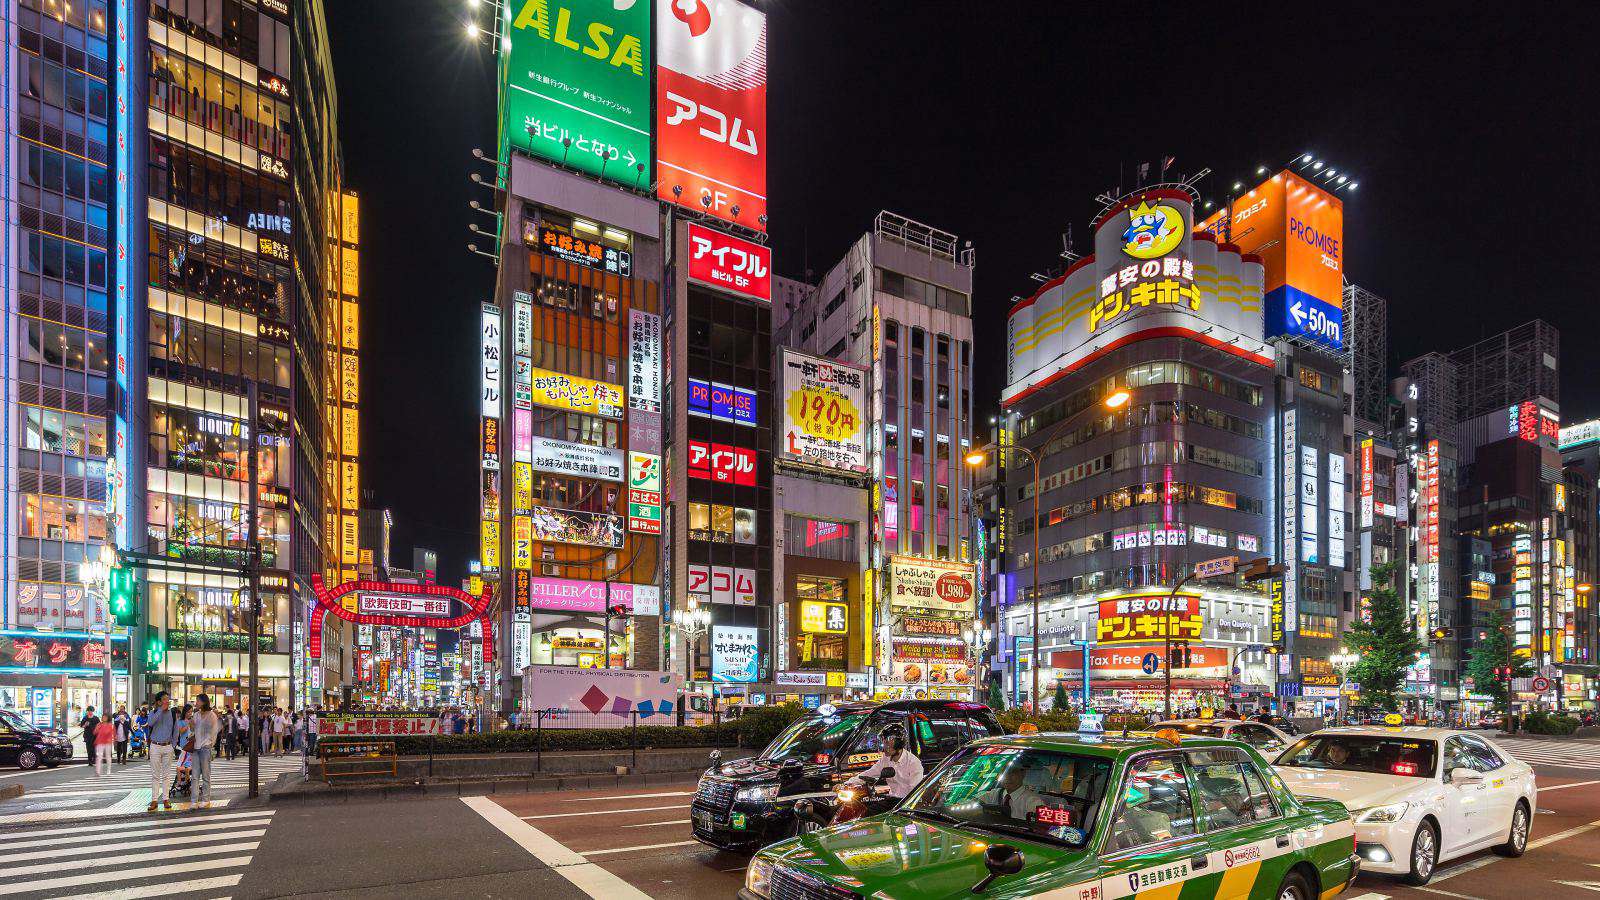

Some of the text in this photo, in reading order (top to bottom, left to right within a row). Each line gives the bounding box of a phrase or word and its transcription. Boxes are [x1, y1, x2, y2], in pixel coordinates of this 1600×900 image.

[514, 0, 644, 76] ALSA
[666, 91, 758, 155] アコム
[524, 115, 619, 160] 当ビルとなり
[1235, 198, 1268, 224] プロミス
[543, 231, 603, 260] お好み焼
[1289, 216, 1339, 259] PROMISE
[692, 235, 767, 278] アイフル
[1320, 253, 1339, 271] プロミス
[711, 269, 749, 287] 当ビル 5F
[1101, 258, 1194, 298] 驚安の殿堂
[1307, 307, 1340, 342] 50m
[484, 324, 498, 401] 小松ビル
[535, 376, 570, 389] お好み
[546, 384, 588, 400] もんじゃ
[593, 384, 619, 403] 焼き
[692, 386, 751, 410] PROMISE
[569, 396, 592, 407] たこ
[727, 406, 751, 418] プロミス
[800, 392, 854, 431] 190円
[806, 421, 842, 437] (税別)
[542, 440, 587, 453] OKONOMIYAKI
[536, 457, 598, 474] お好み焼き本陣
[690, 445, 754, 473] アイフル
[717, 471, 728, 480] 5F
[631, 491, 658, 504] たばこ
[639, 506, 651, 517] 酒
[690, 570, 753, 594] アコム
[896, 567, 936, 579] しゃぶしゃぶ
[19, 585, 83, 606] ダーツ
[532, 583, 632, 602] FILLER CLNIC
[20, 607, 47, 616] CAFE
[364, 597, 447, 613] 歌舞伎町一番街
[1219, 618, 1229, 627] Don
[715, 643, 752, 655] すしまみれ
[1090, 653, 1141, 666] Tax Free
[1038, 807, 1070, 825] 空車
[1141, 864, 1188, 887] 宝自動車交通
